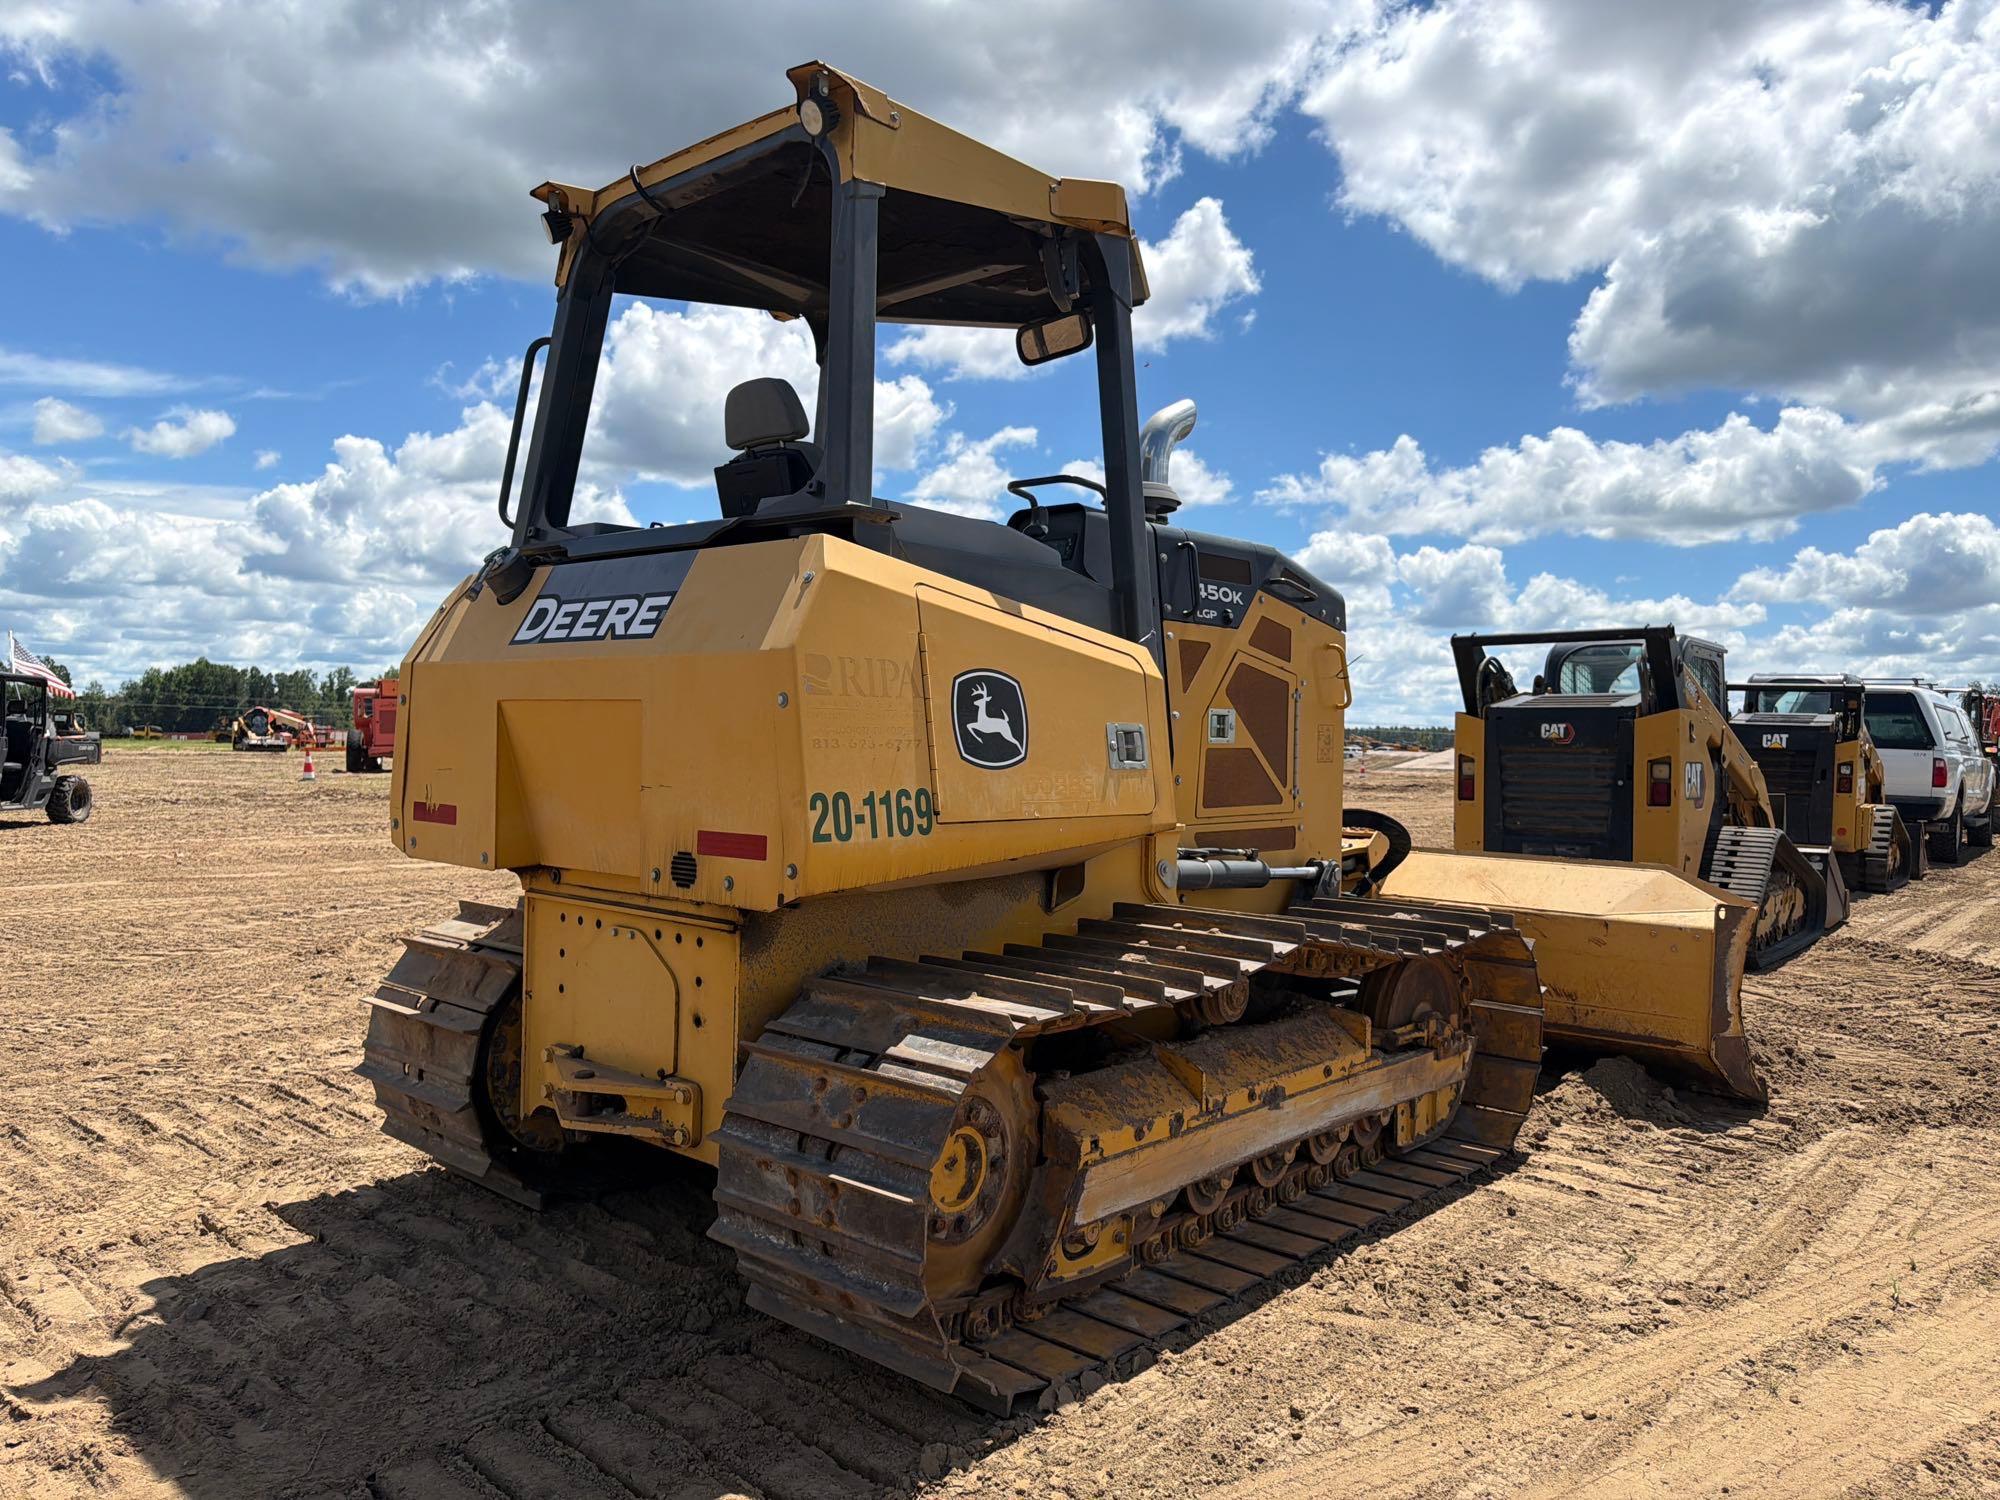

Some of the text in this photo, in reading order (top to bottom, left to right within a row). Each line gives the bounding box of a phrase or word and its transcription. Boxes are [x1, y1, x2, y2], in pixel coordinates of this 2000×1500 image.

[1199, 582, 1244, 606] 450K
[513, 595, 673, 642] DEERE
[1196, 608, 1218, 619] LGP
[838, 655, 924, 699] RIPA
[1540, 723, 1567, 739] CAT
[1762, 733, 1790, 749] CAT
[1685, 761, 1702, 800] CAT
[809, 787, 934, 844] 20-1169
